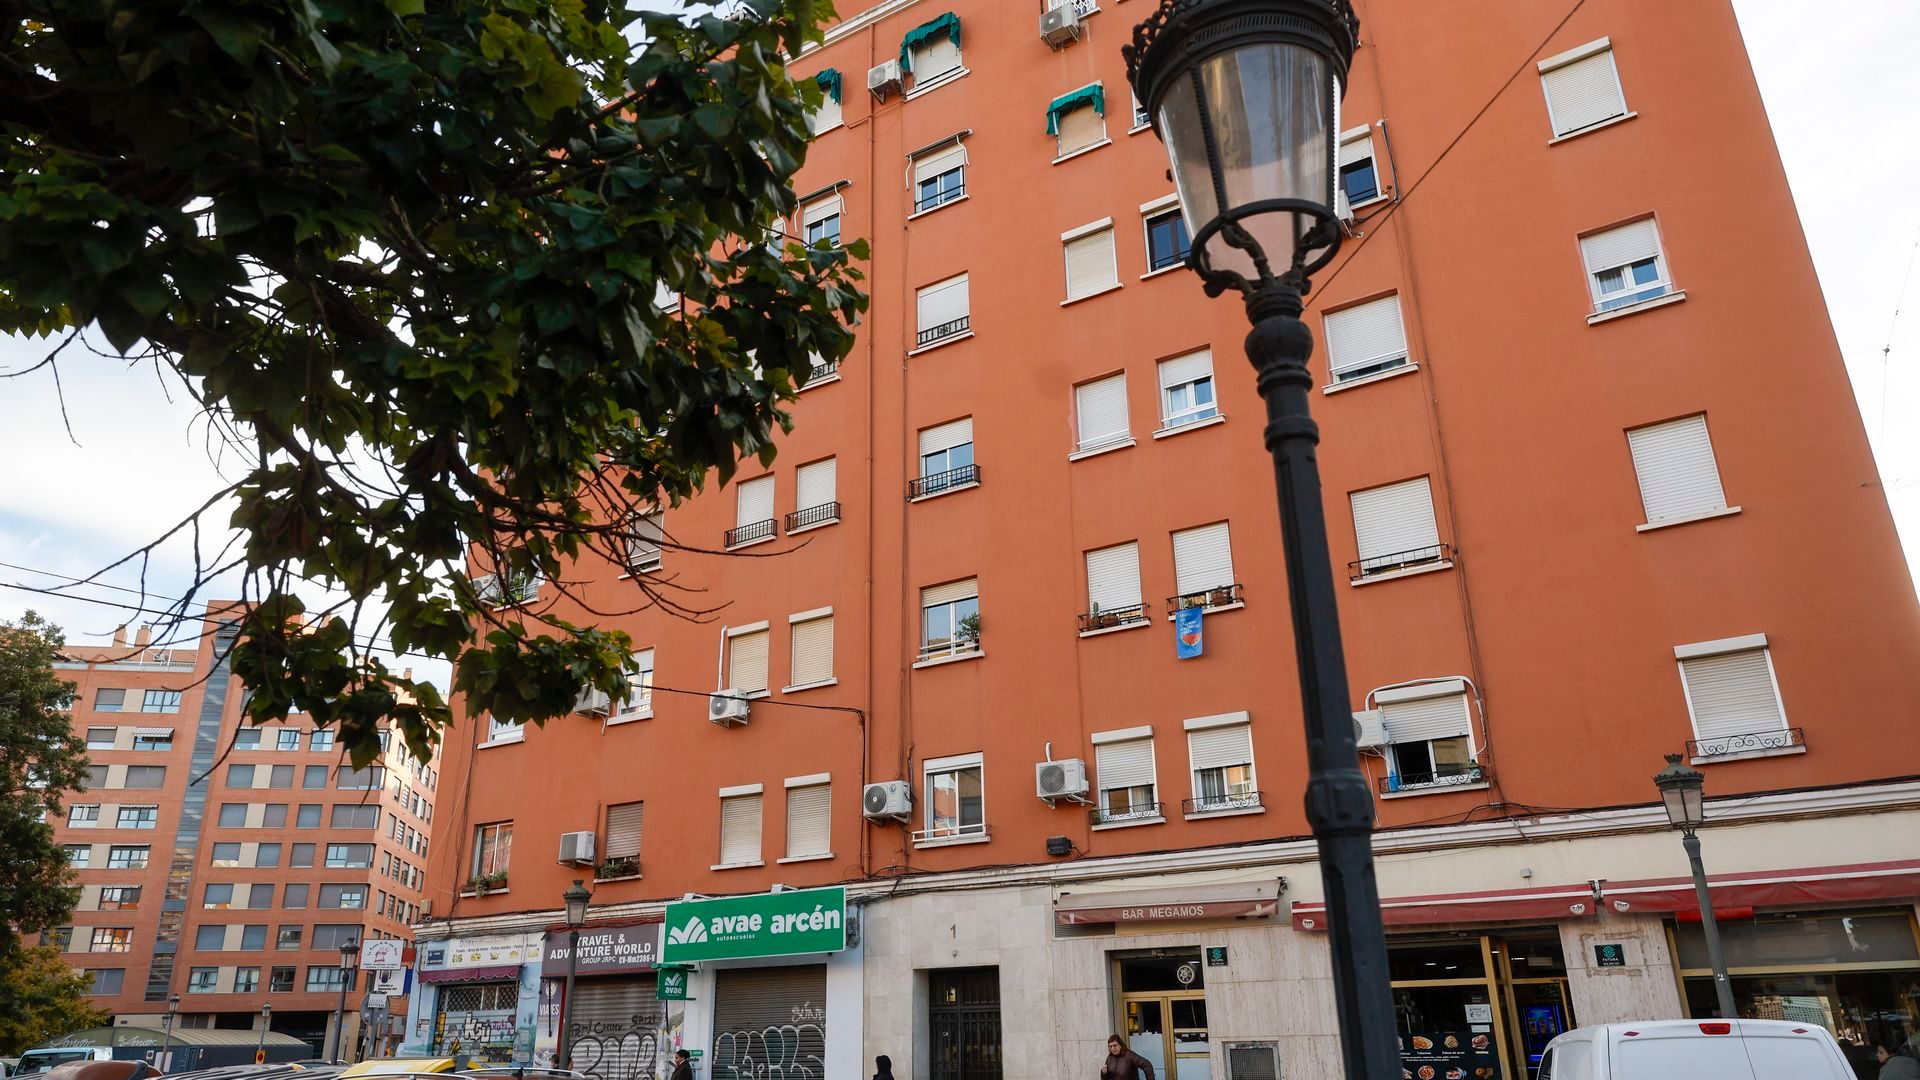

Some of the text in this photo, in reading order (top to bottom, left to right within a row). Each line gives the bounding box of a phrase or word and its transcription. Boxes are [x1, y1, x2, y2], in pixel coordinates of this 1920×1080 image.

[1122, 906, 1204, 919] BAR MEGAMOS
[711, 904, 840, 935] avae arcén
[716, 933, 755, 941] autoescuelas
[950, 924, 956, 939] 1
[618, 933, 625, 944] &
[550, 942, 651, 960] ADVNTURE WORLD
[1717, 973, 1725, 981] 2
[664, 986, 682, 994] avae
[540, 1003, 560, 1016] VIAES
